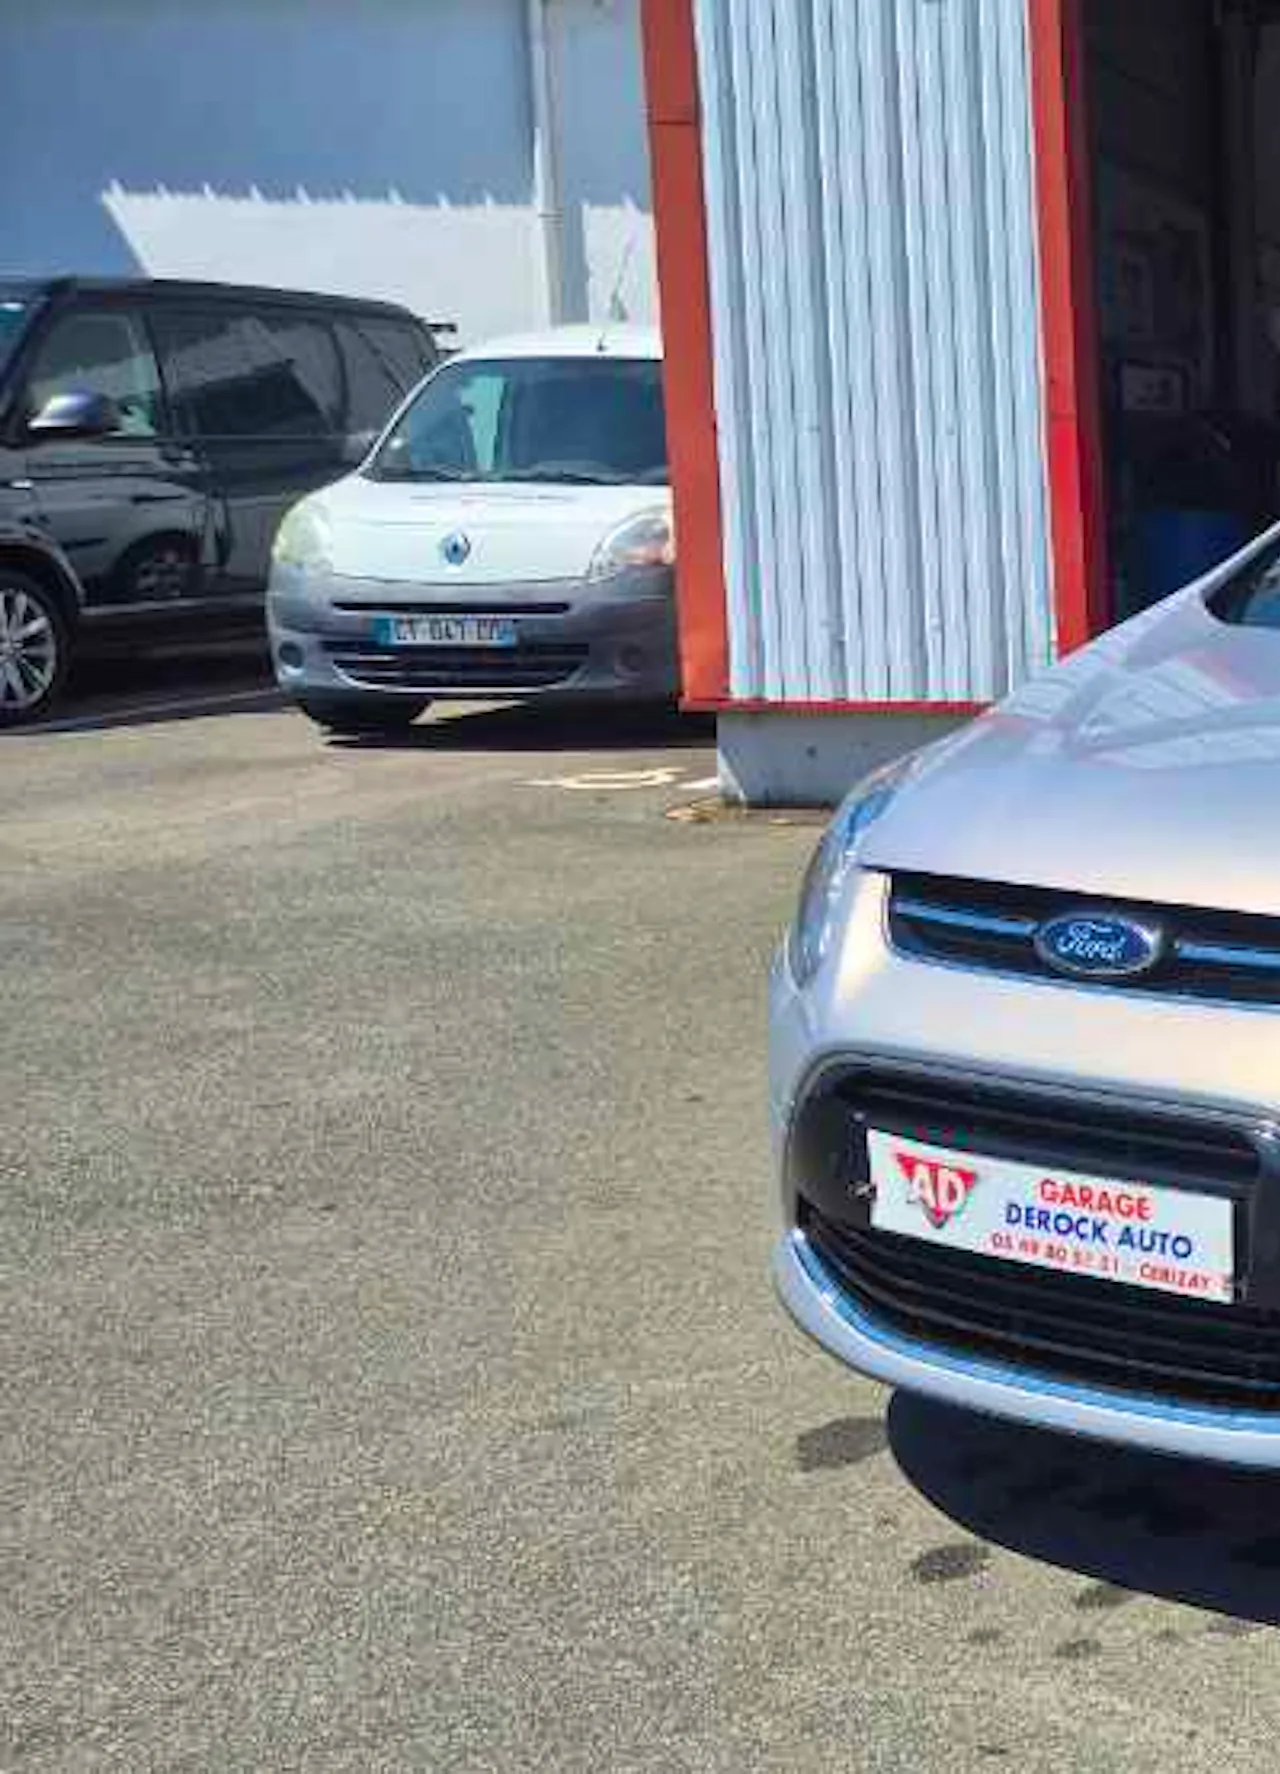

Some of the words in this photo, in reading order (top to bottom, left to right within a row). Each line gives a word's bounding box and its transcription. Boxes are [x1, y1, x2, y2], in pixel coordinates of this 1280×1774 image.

[1056, 920, 1126, 961] Ford
[907, 1162, 968, 1213] AD
[1040, 1178, 1151, 1221] GARAGE
[1005, 1203, 1109, 1244] DEROCK
[1118, 1226, 1193, 1259] AUTO
[1140, 1262, 1209, 1288] CERIZAY
